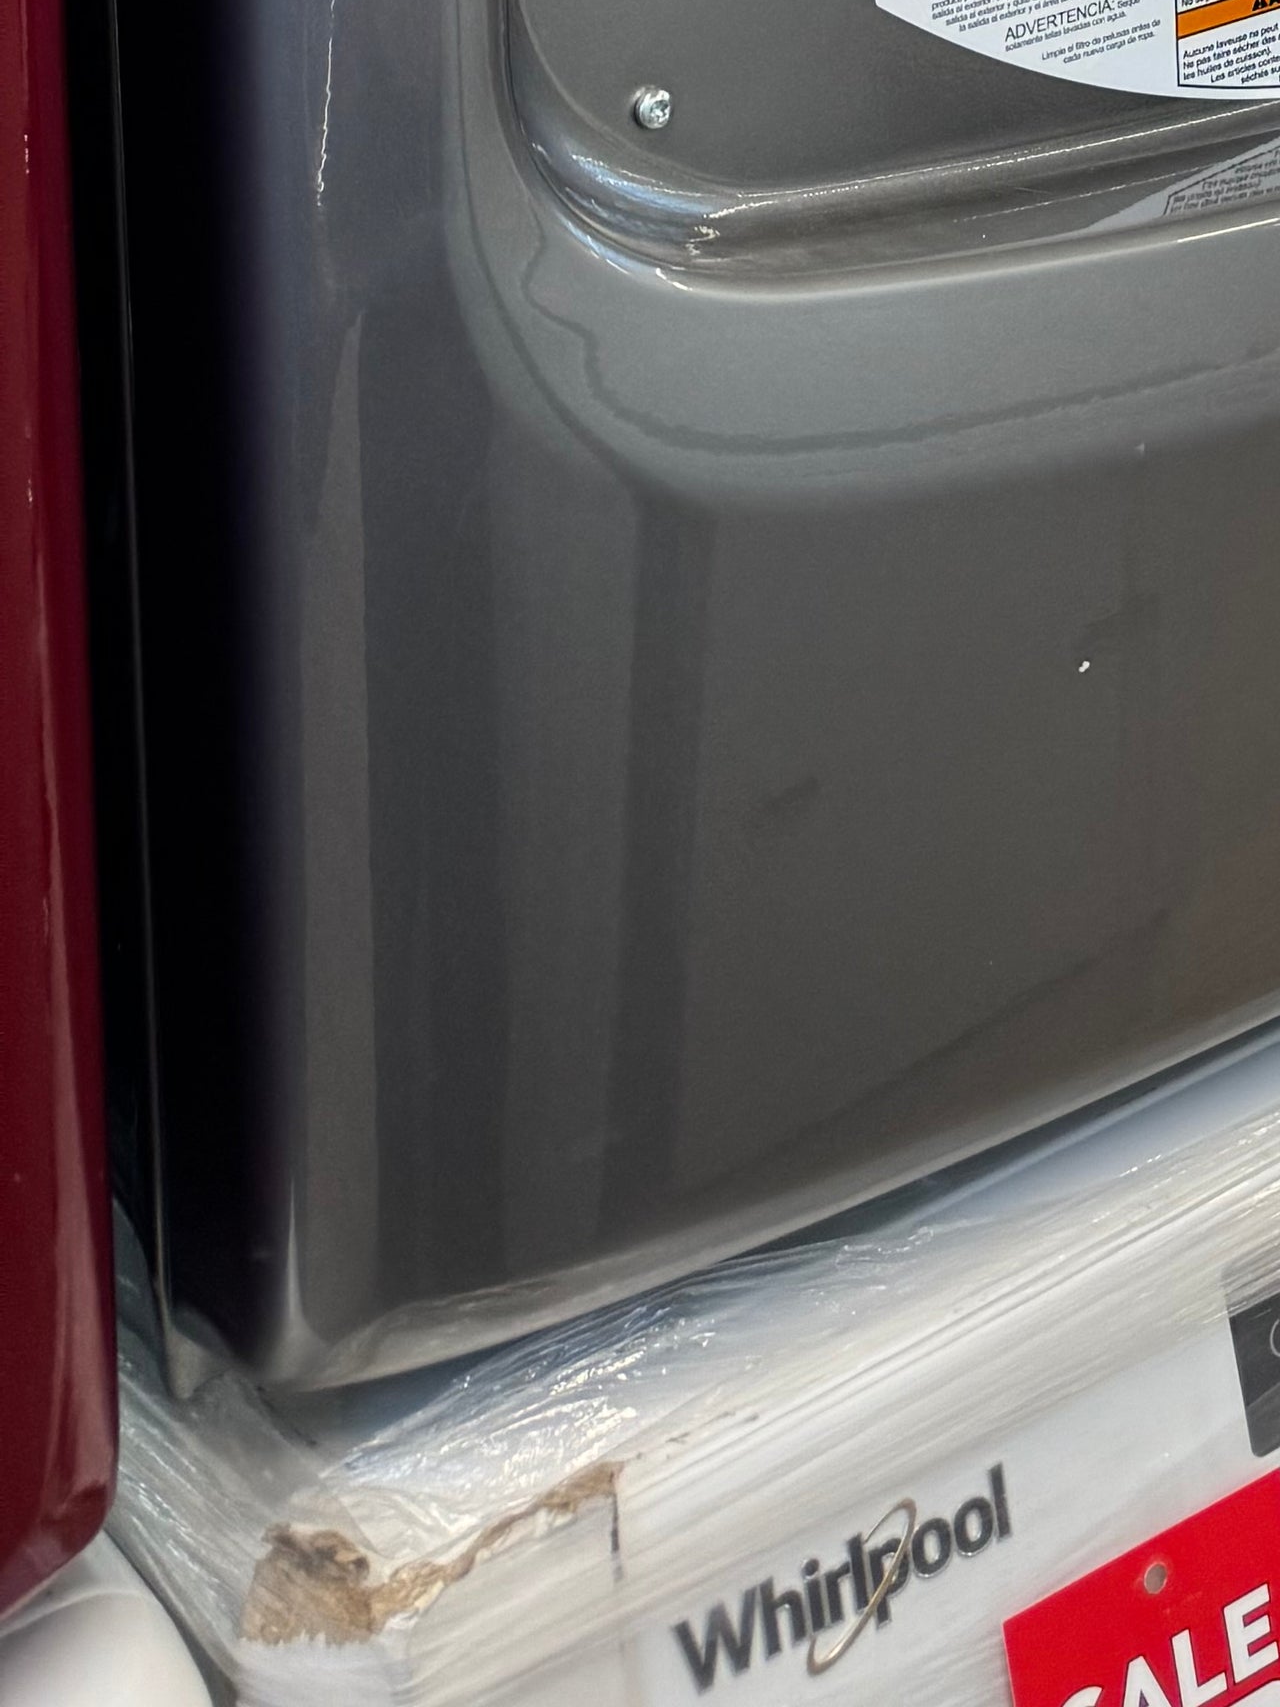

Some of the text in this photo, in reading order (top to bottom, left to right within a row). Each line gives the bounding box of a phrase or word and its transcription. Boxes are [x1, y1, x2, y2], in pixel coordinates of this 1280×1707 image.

[1004, 0, 1116, 43] ADVERTENCIA:
[671, 1462, 1014, 1696] Whirlpool
[1062, 1583, 1280, 1707] ALE
